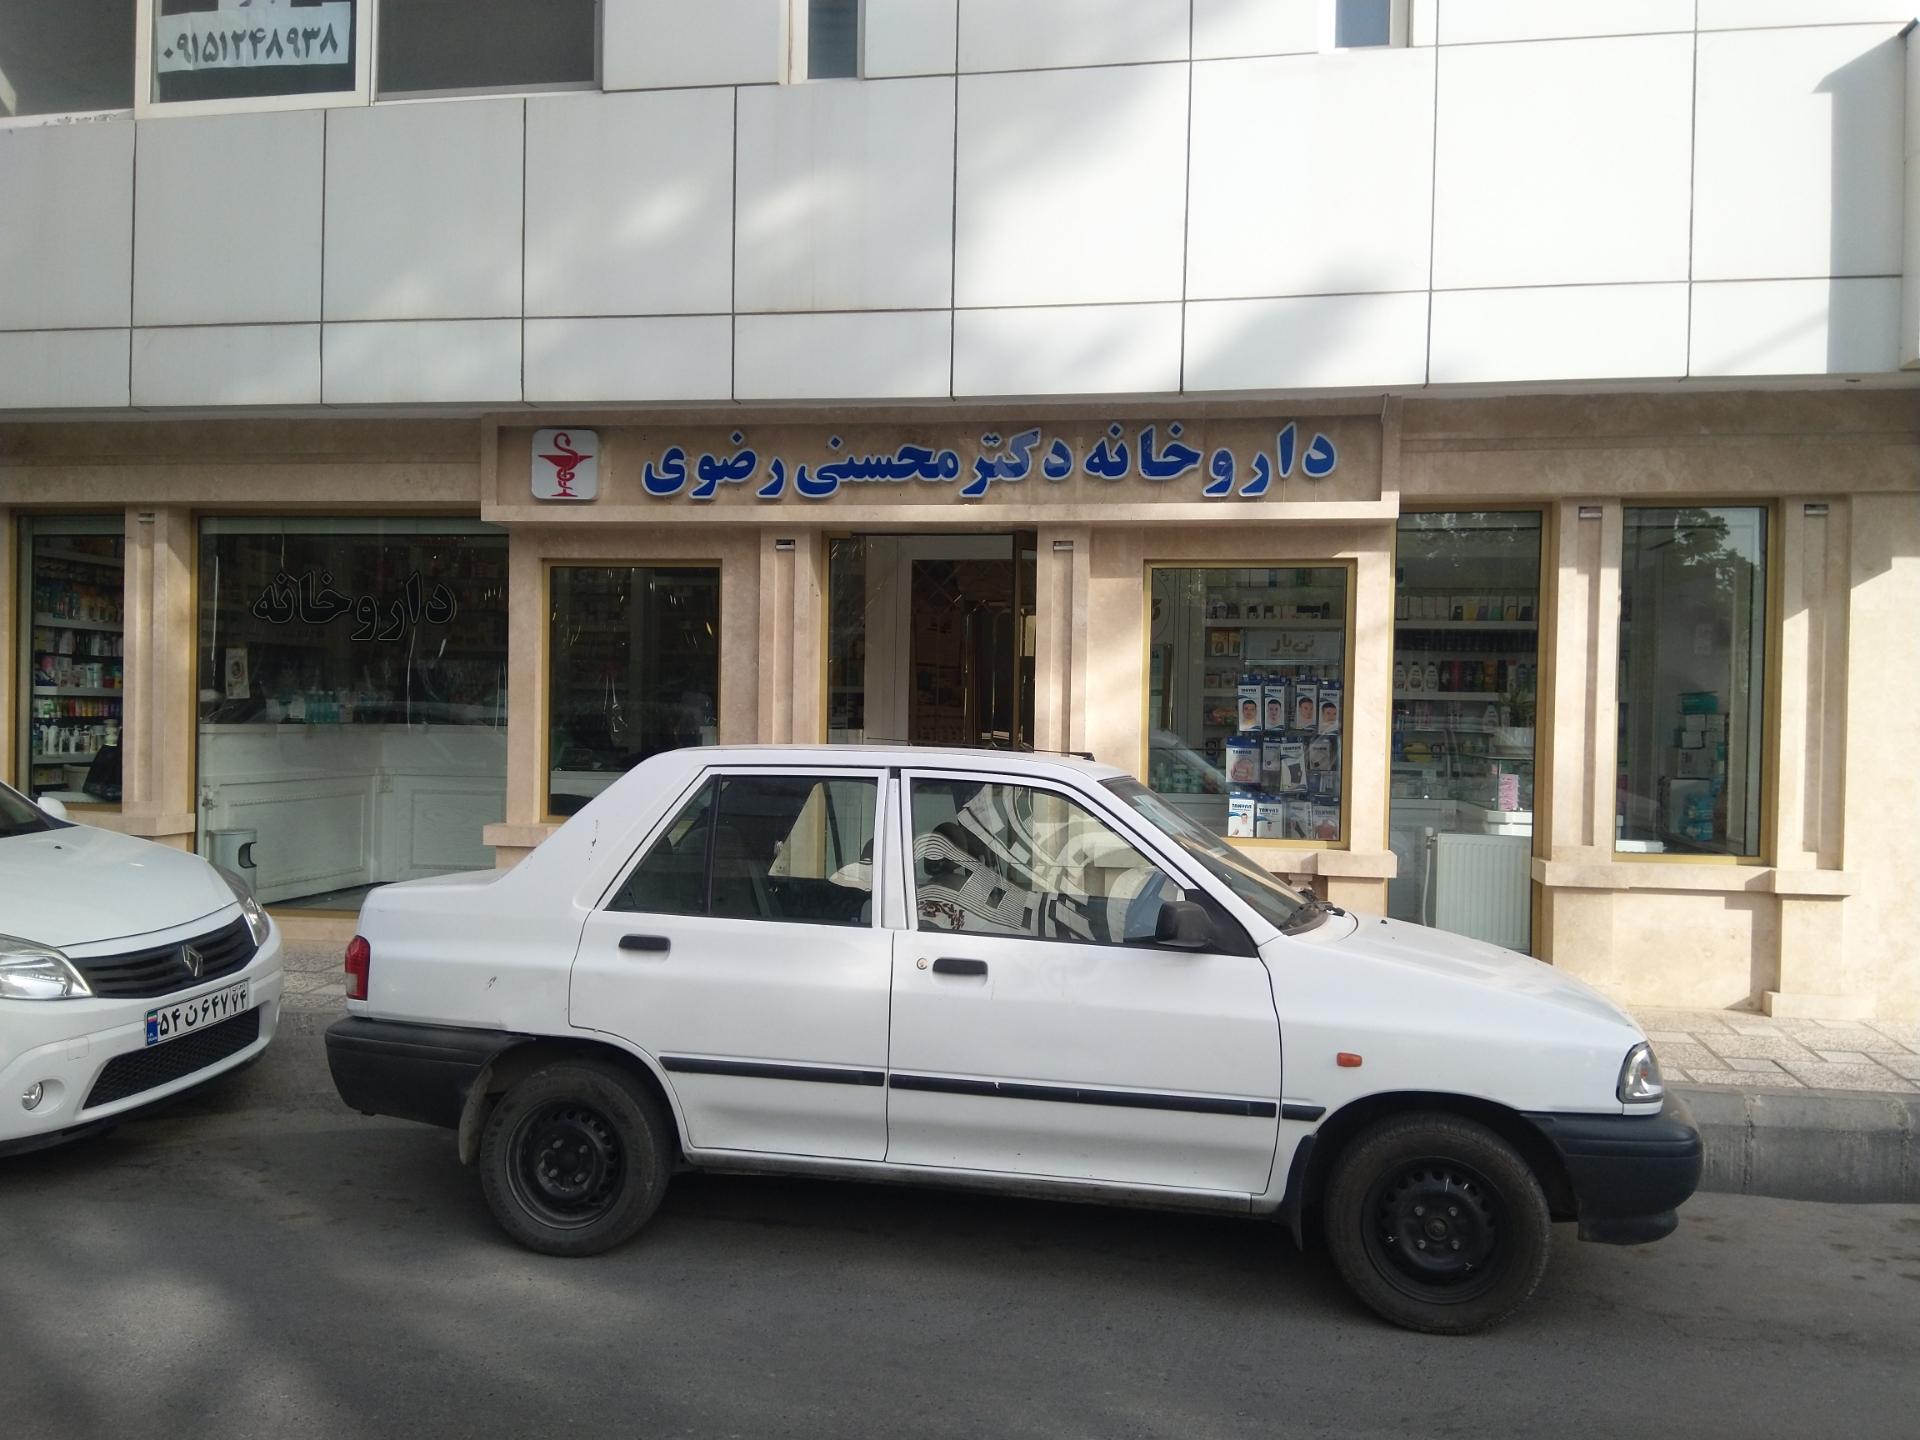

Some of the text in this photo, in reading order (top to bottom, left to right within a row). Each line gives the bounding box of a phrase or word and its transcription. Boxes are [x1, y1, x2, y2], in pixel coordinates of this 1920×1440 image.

[641, 421, 1338, 499] داروخانه دکتر محسنی رضوی
[252, 570, 458, 641] داروخانه
